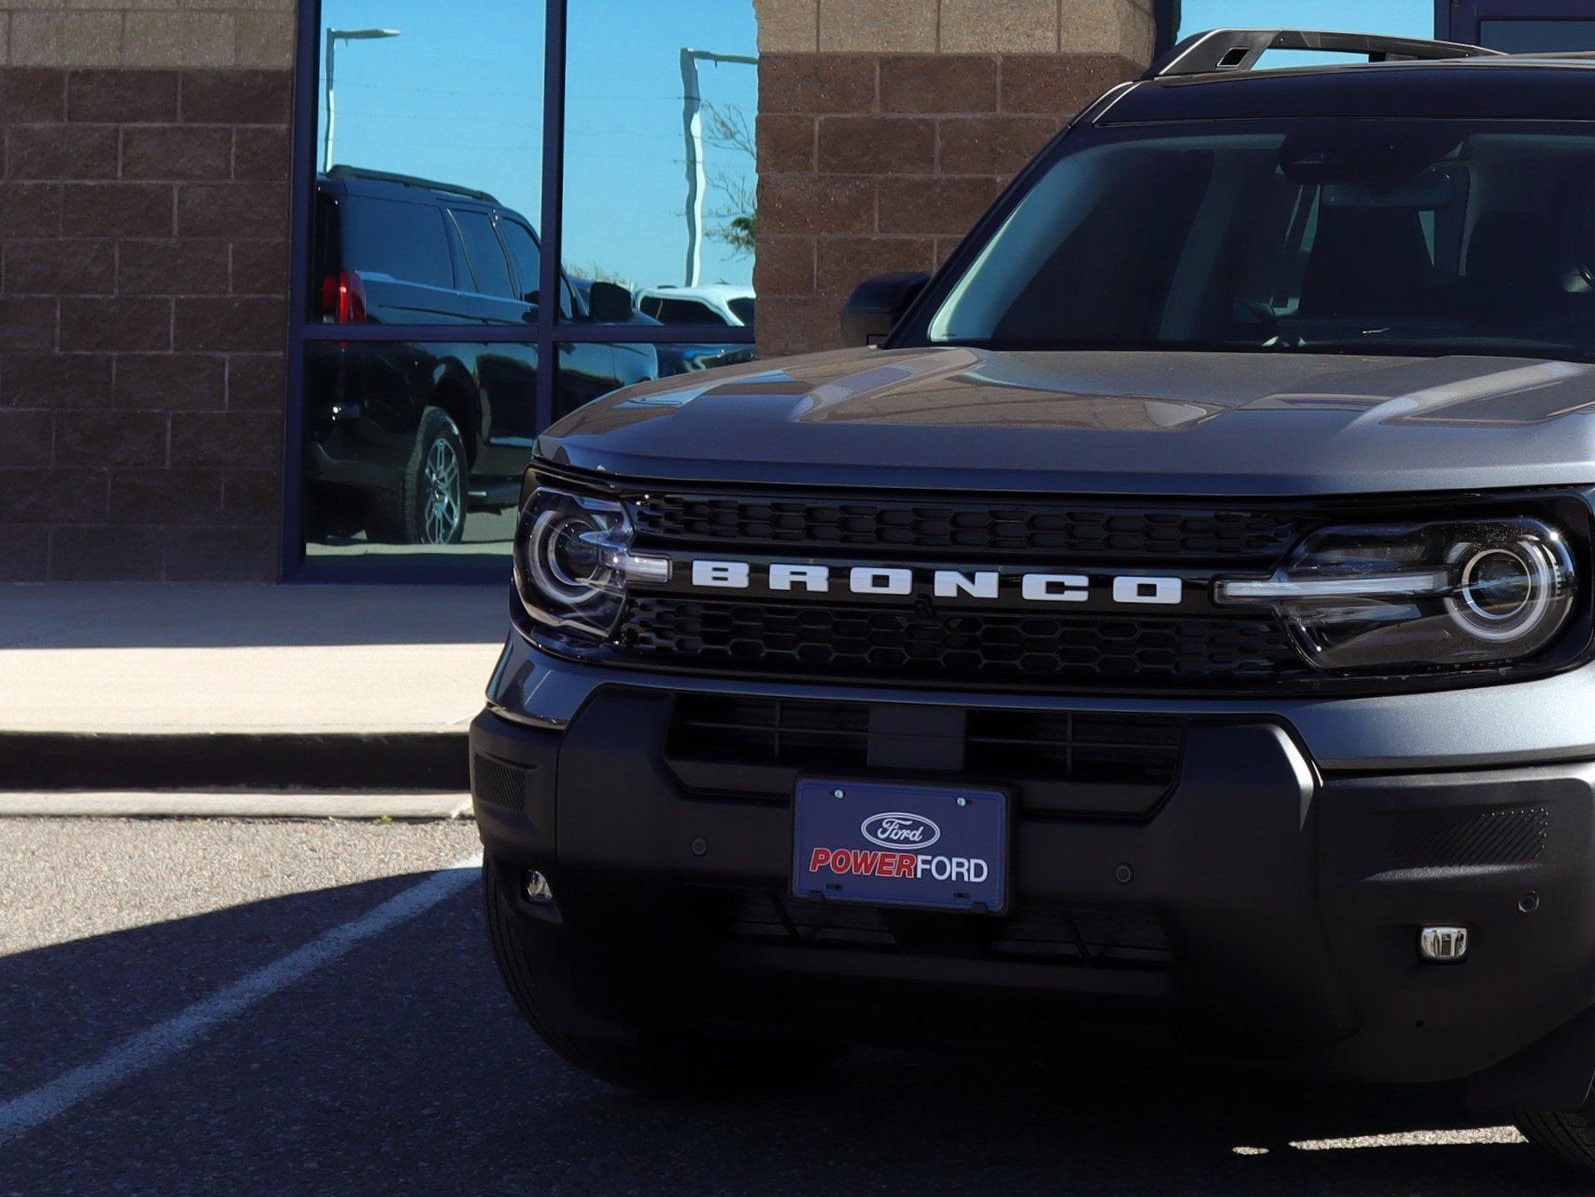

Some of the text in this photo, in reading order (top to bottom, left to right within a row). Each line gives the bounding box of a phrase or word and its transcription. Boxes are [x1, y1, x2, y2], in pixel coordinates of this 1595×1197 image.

[692, 559, 1183, 604] BRONCO
[876, 818, 924, 842] Ford
[809, 847, 988, 883] POWERFORD
